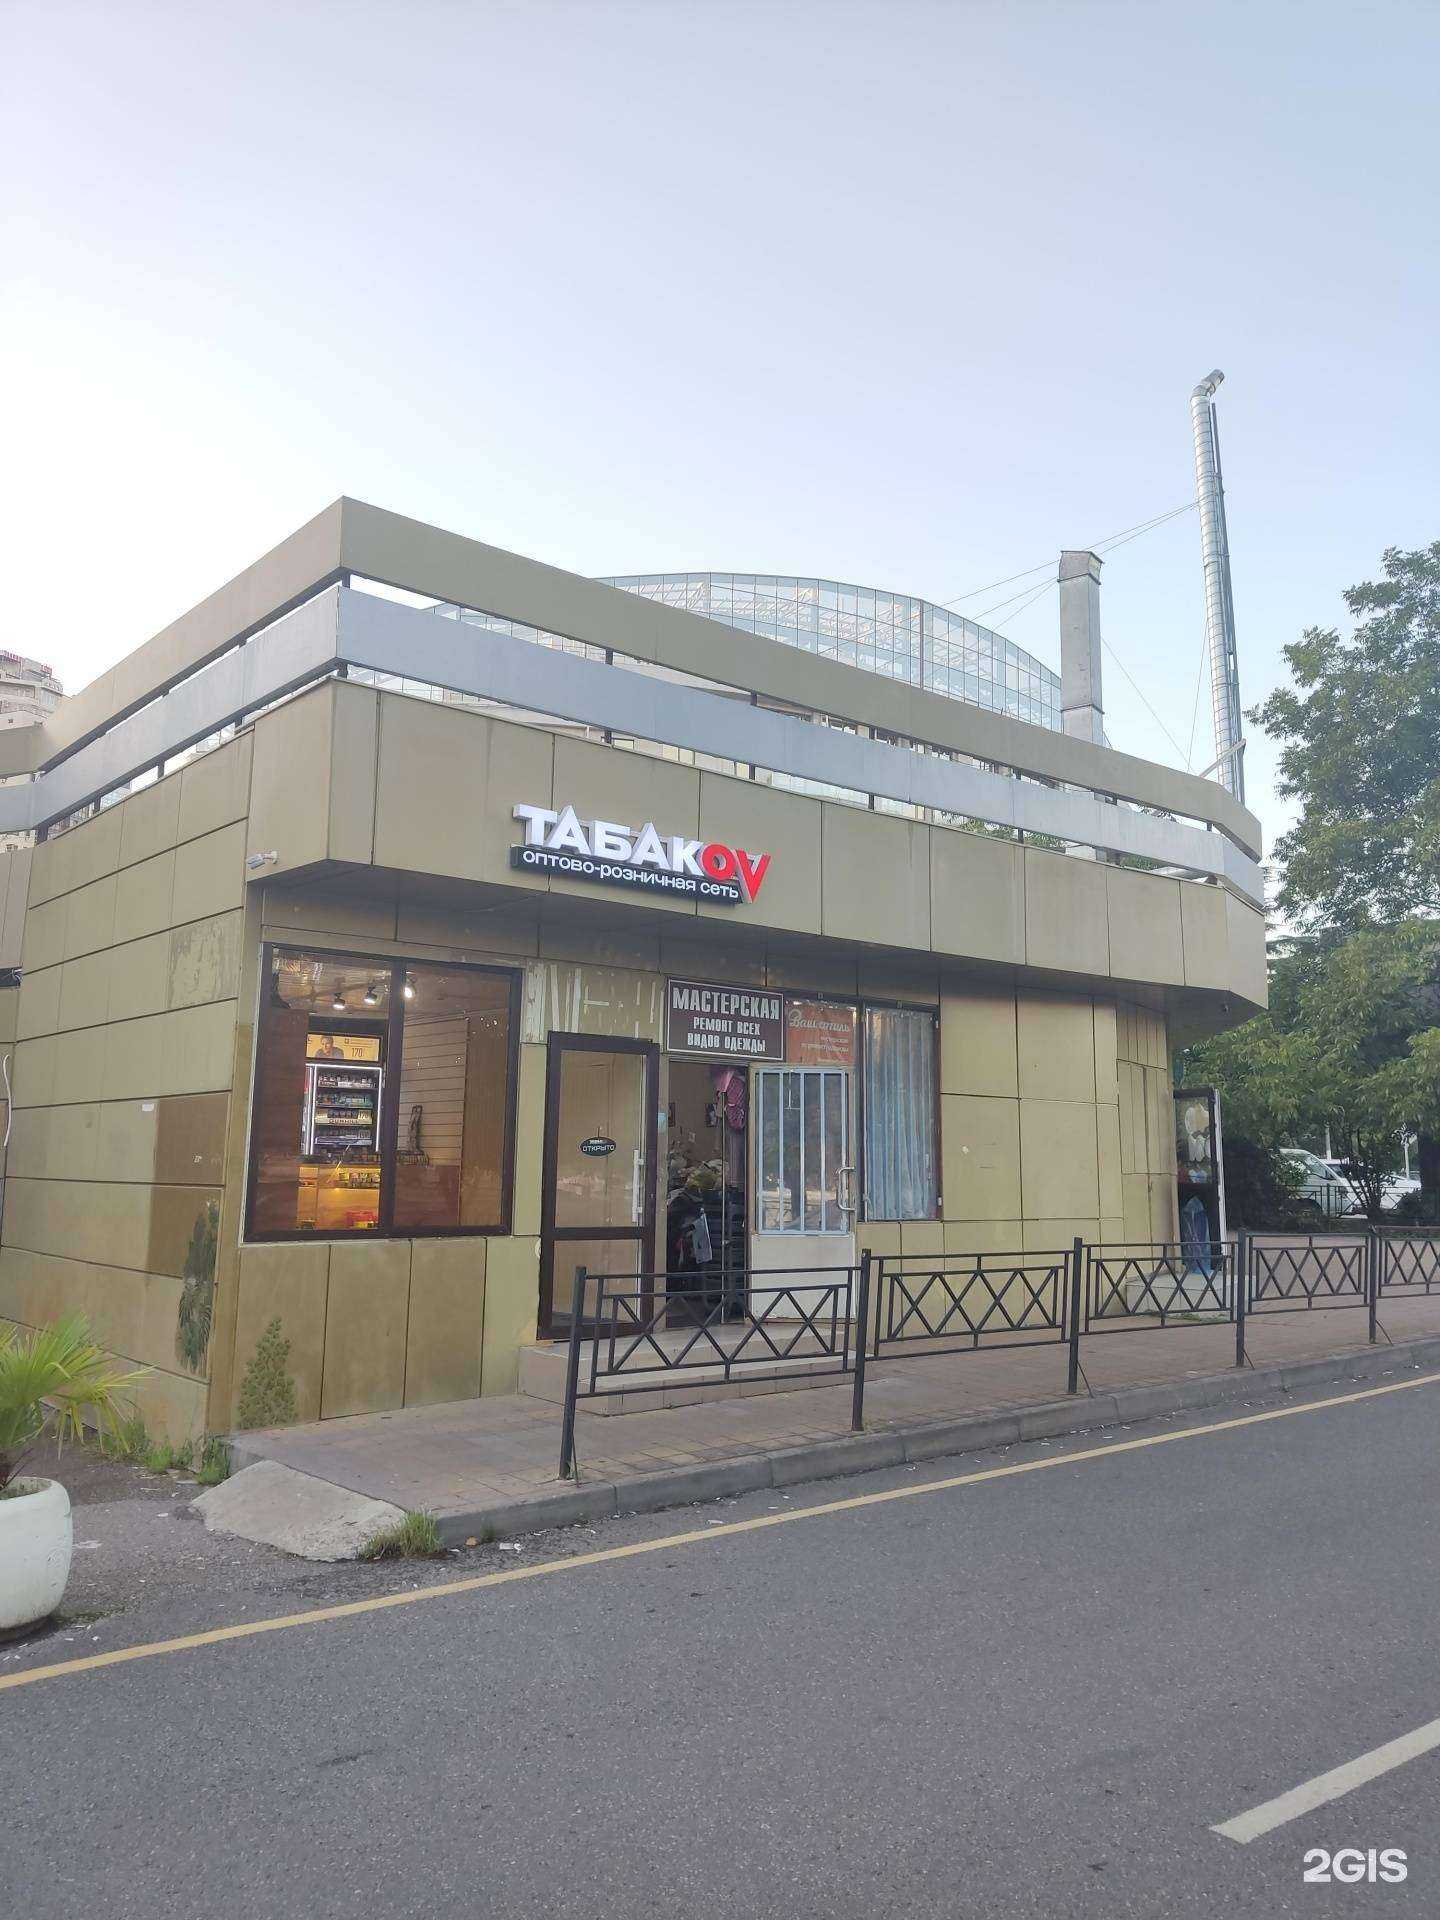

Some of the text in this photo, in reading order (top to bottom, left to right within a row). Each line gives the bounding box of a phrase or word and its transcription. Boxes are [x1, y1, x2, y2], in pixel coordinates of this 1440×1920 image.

[522, 850, 739, 899] оптово-розничная сеть
[672, 987, 780, 1019] МАСТЕРСКАЯ
[693, 1016, 761, 1036] РЕМОНТ ВСЕХ
[687, 1032, 766, 1053] ВИДОВ ОДЕЖДЫ
[582, 1144, 616, 1152] ОТКРЫТО
